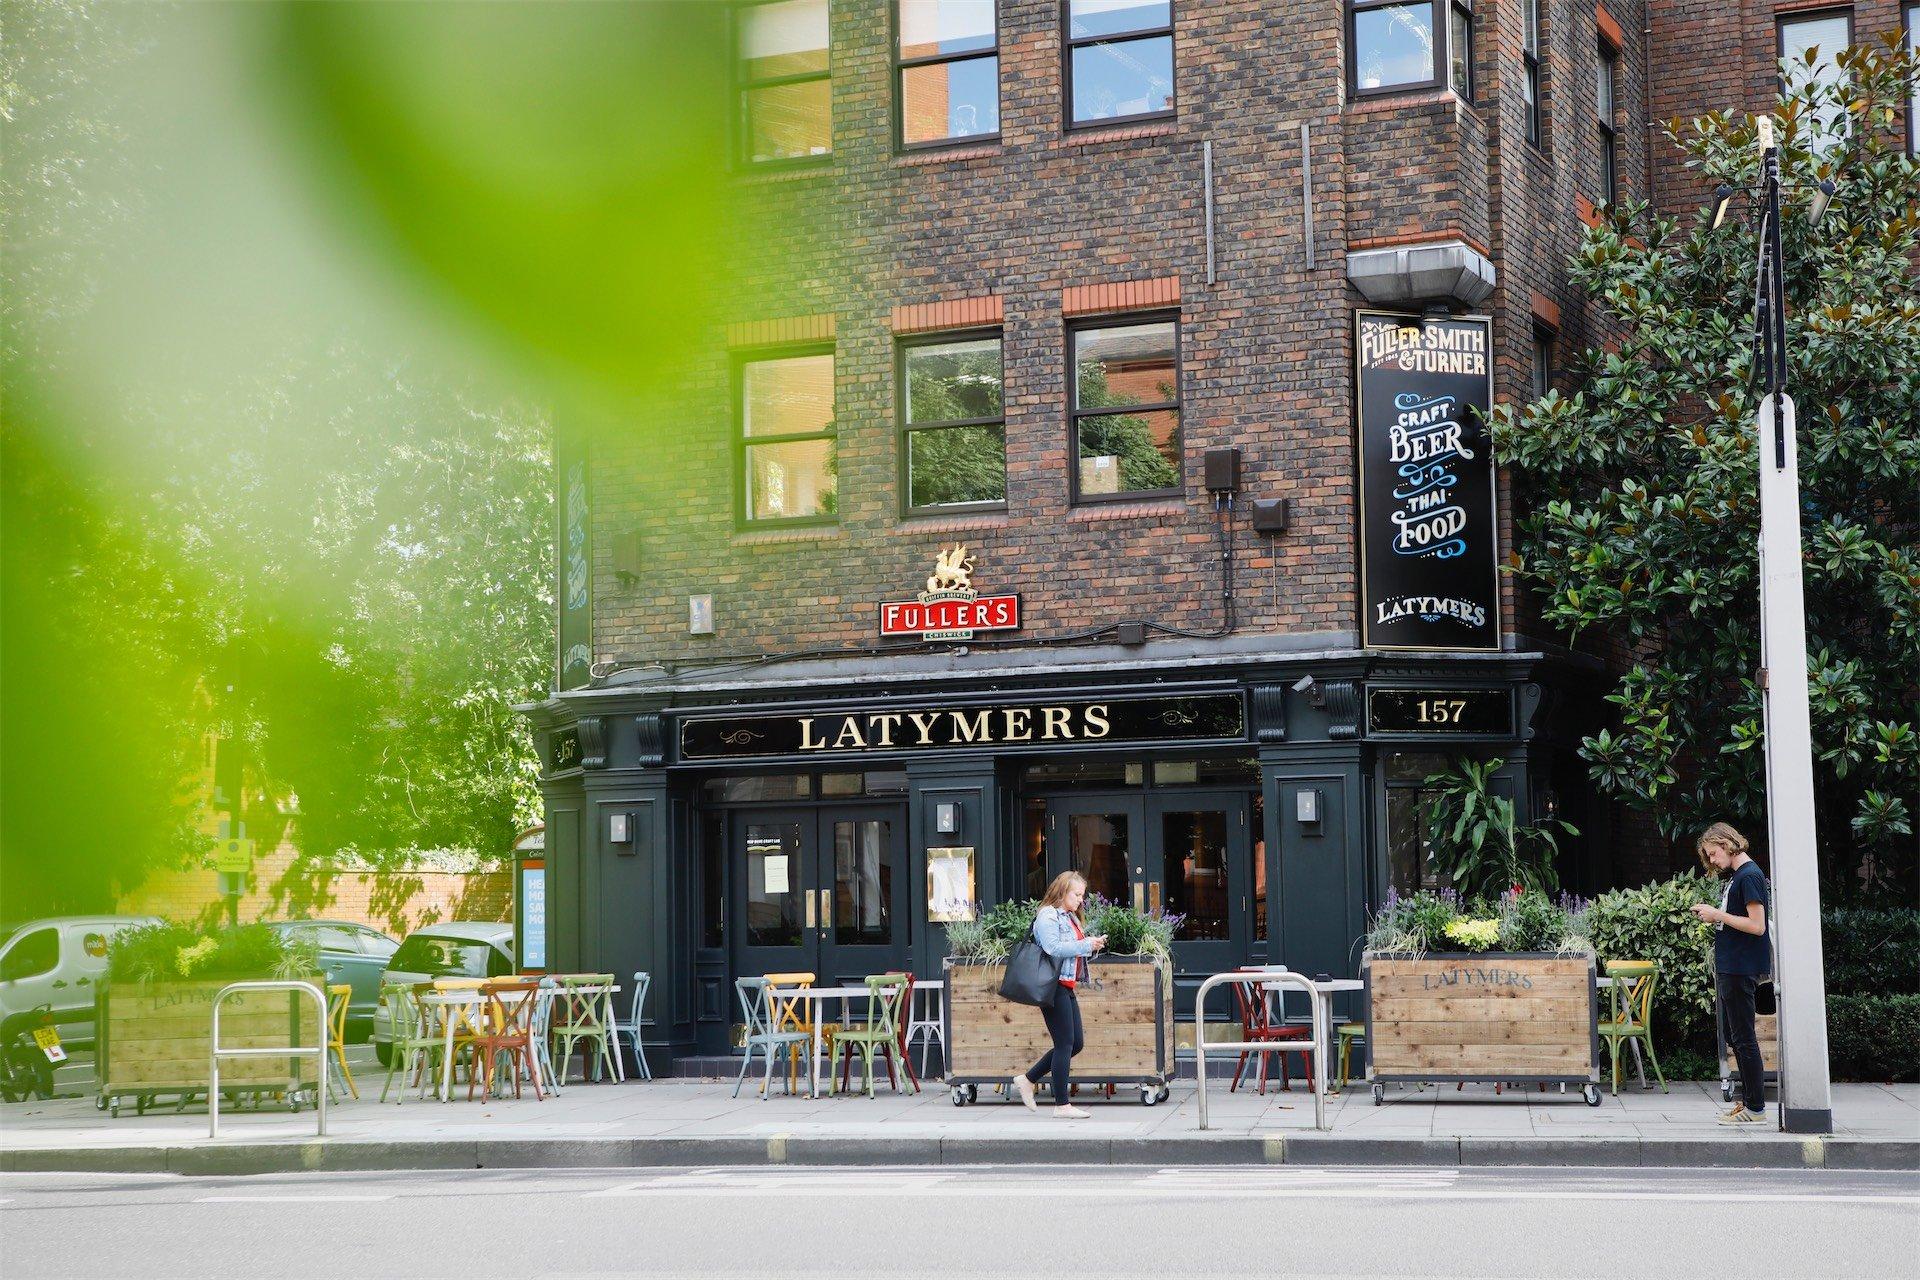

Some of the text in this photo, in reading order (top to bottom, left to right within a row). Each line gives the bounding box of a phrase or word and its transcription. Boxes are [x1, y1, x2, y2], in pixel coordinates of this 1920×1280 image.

[1361, 325, 1485, 368] FULLER SMITH
[1413, 349, 1486, 375] TURNER
[1397, 403, 1450, 427] CRAFT
[1389, 421, 1474, 462] BEER
[1407, 489, 1446, 512] THAI
[1391, 505, 1467, 549] FOOD
[887, 599, 1009, 629] FULLER'S
[1376, 596, 1486, 627] LATYMERS
[1416, 699, 1467, 723] 157
[798, 704, 1112, 751] LATYMERS
[1422, 967, 1533, 991] LATYMERS
[152, 988, 245, 1010] LATYMRS
